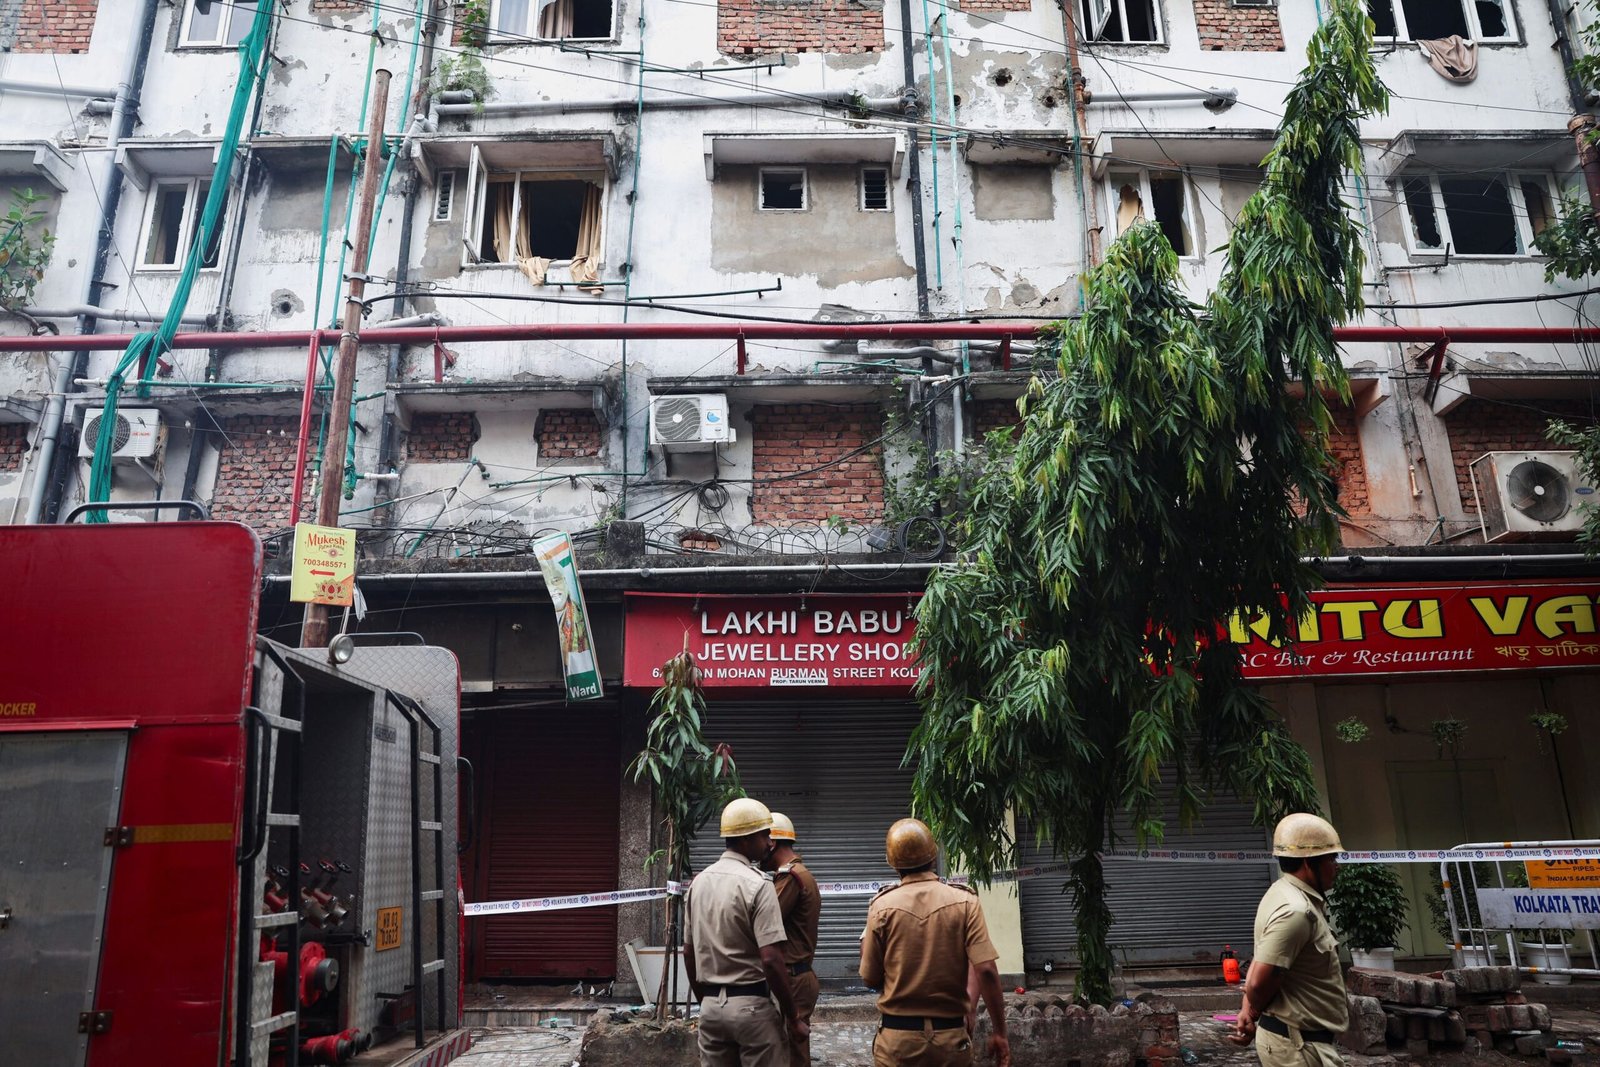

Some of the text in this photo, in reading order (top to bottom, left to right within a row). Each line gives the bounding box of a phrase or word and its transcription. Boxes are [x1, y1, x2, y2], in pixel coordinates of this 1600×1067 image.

[308, 532, 345, 547] Mukesh
[702, 610, 922, 635] LAKHI BABU'
[1471, 595, 1600, 639] VA
[697, 642, 840, 662] JEWELLERY
[1354, 646, 1475, 668] Restaurant
[1494, 645, 1531, 661] ঋতু
[652, 667, 663, 678] 6
[717, 667, 766, 678] MOHAN
[770, 667, 827, 678] BURMAN
[833, 667, 885, 678] STREET
[570, 682, 598, 698] Ward
[1513, 895, 1600, 914] KOLKATA TRA
